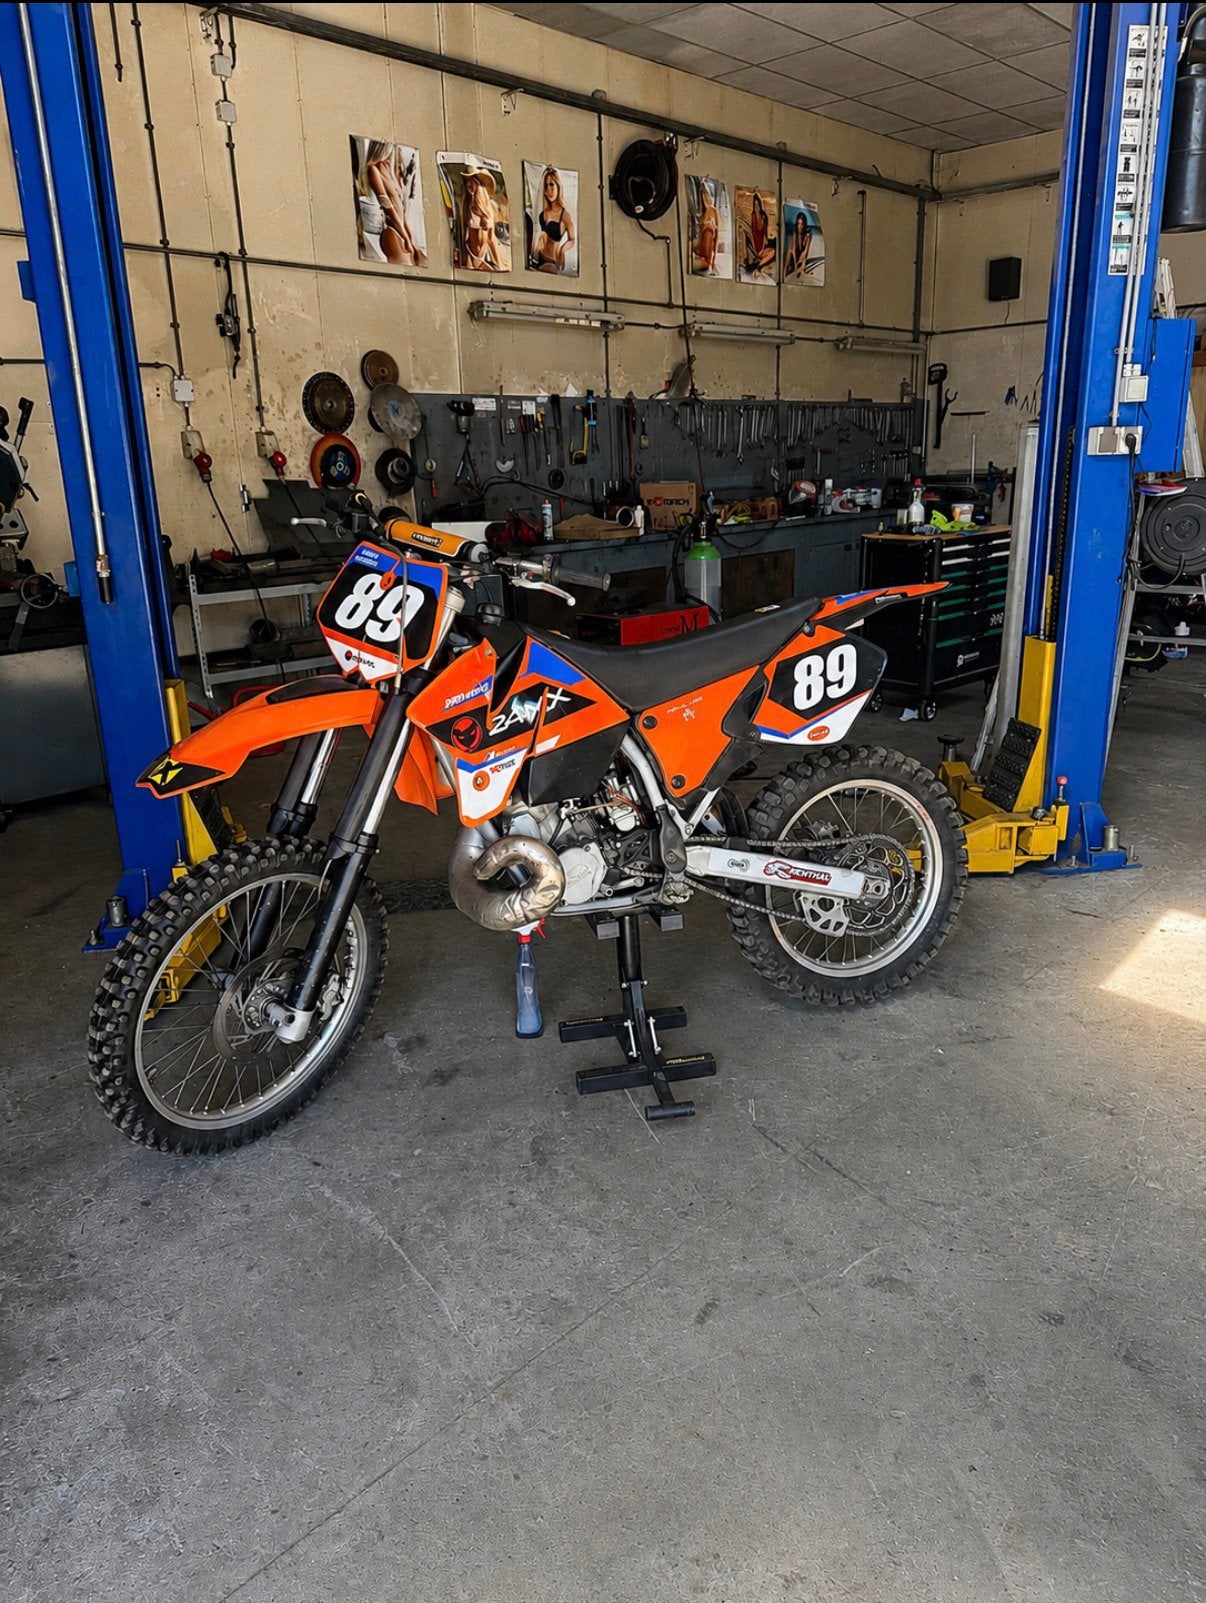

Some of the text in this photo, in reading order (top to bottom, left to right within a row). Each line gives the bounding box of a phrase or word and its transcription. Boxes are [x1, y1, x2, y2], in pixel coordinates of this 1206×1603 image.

[334, 573, 425, 643] 89
[793, 644, 857, 711] 89
[764, 860, 832, 883] RENTHAL
